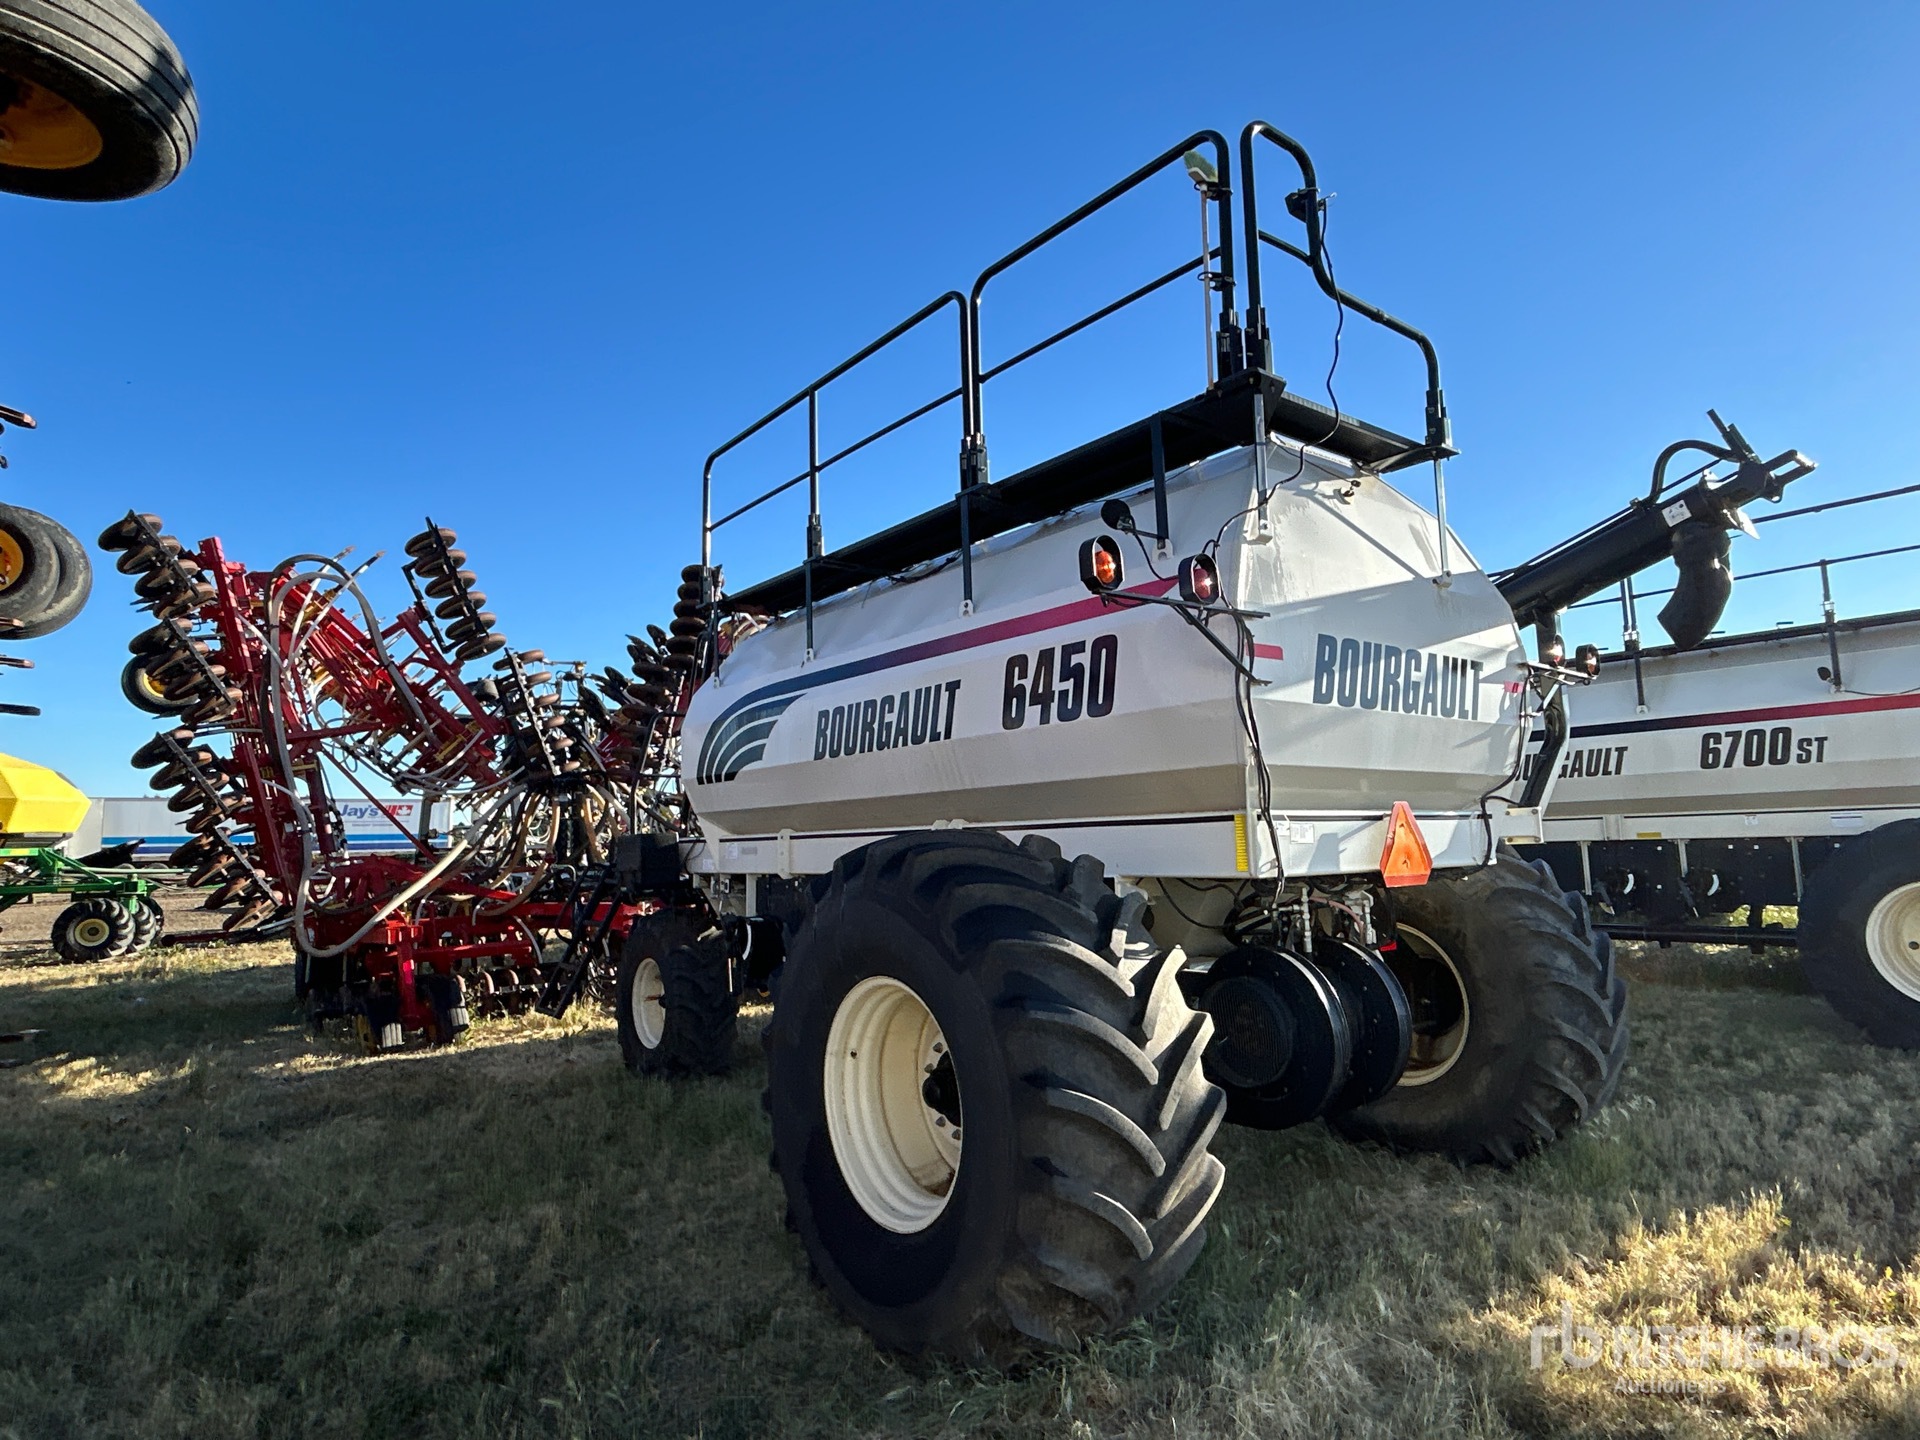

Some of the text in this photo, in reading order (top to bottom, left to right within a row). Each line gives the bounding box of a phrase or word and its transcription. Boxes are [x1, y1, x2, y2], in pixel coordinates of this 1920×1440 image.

[813, 634, 1118, 761] BOURGAULT 6450
[1313, 633, 1484, 721] BOURGAULT
[1515, 726, 1828, 781] UGAULT 6700 ST
[340, 804, 379, 819] Jay's
